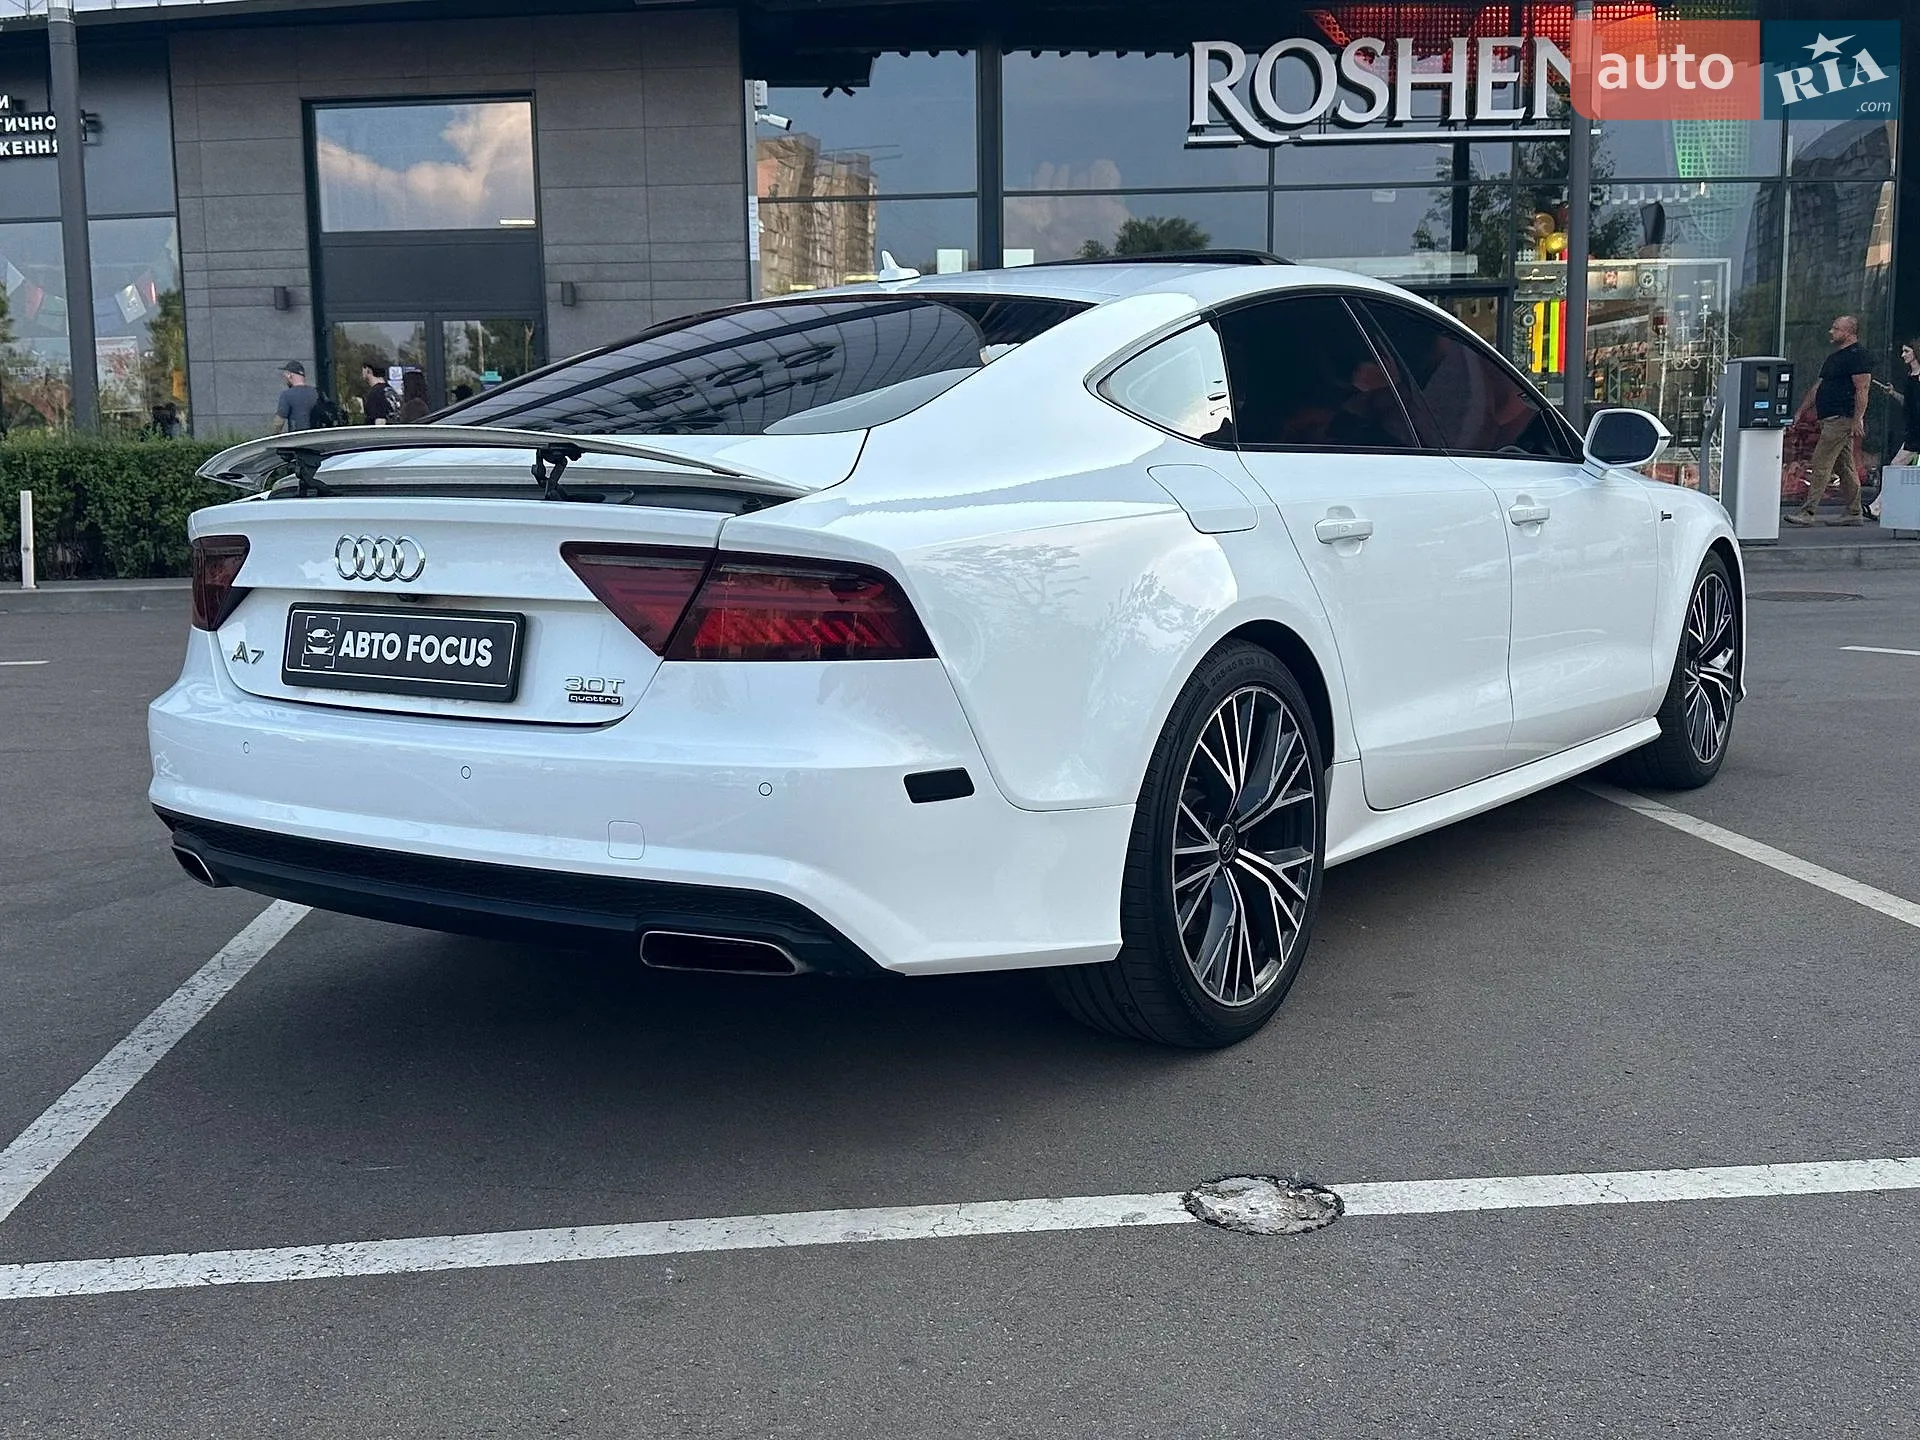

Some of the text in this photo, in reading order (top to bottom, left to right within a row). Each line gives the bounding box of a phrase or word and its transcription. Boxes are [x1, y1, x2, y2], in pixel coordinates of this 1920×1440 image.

[1189, 36, 1575, 142] ROSHEN
[231, 641, 264, 664] A7
[406, 634, 493, 668] FOCUS
[569, 694, 620, 704] quattro
